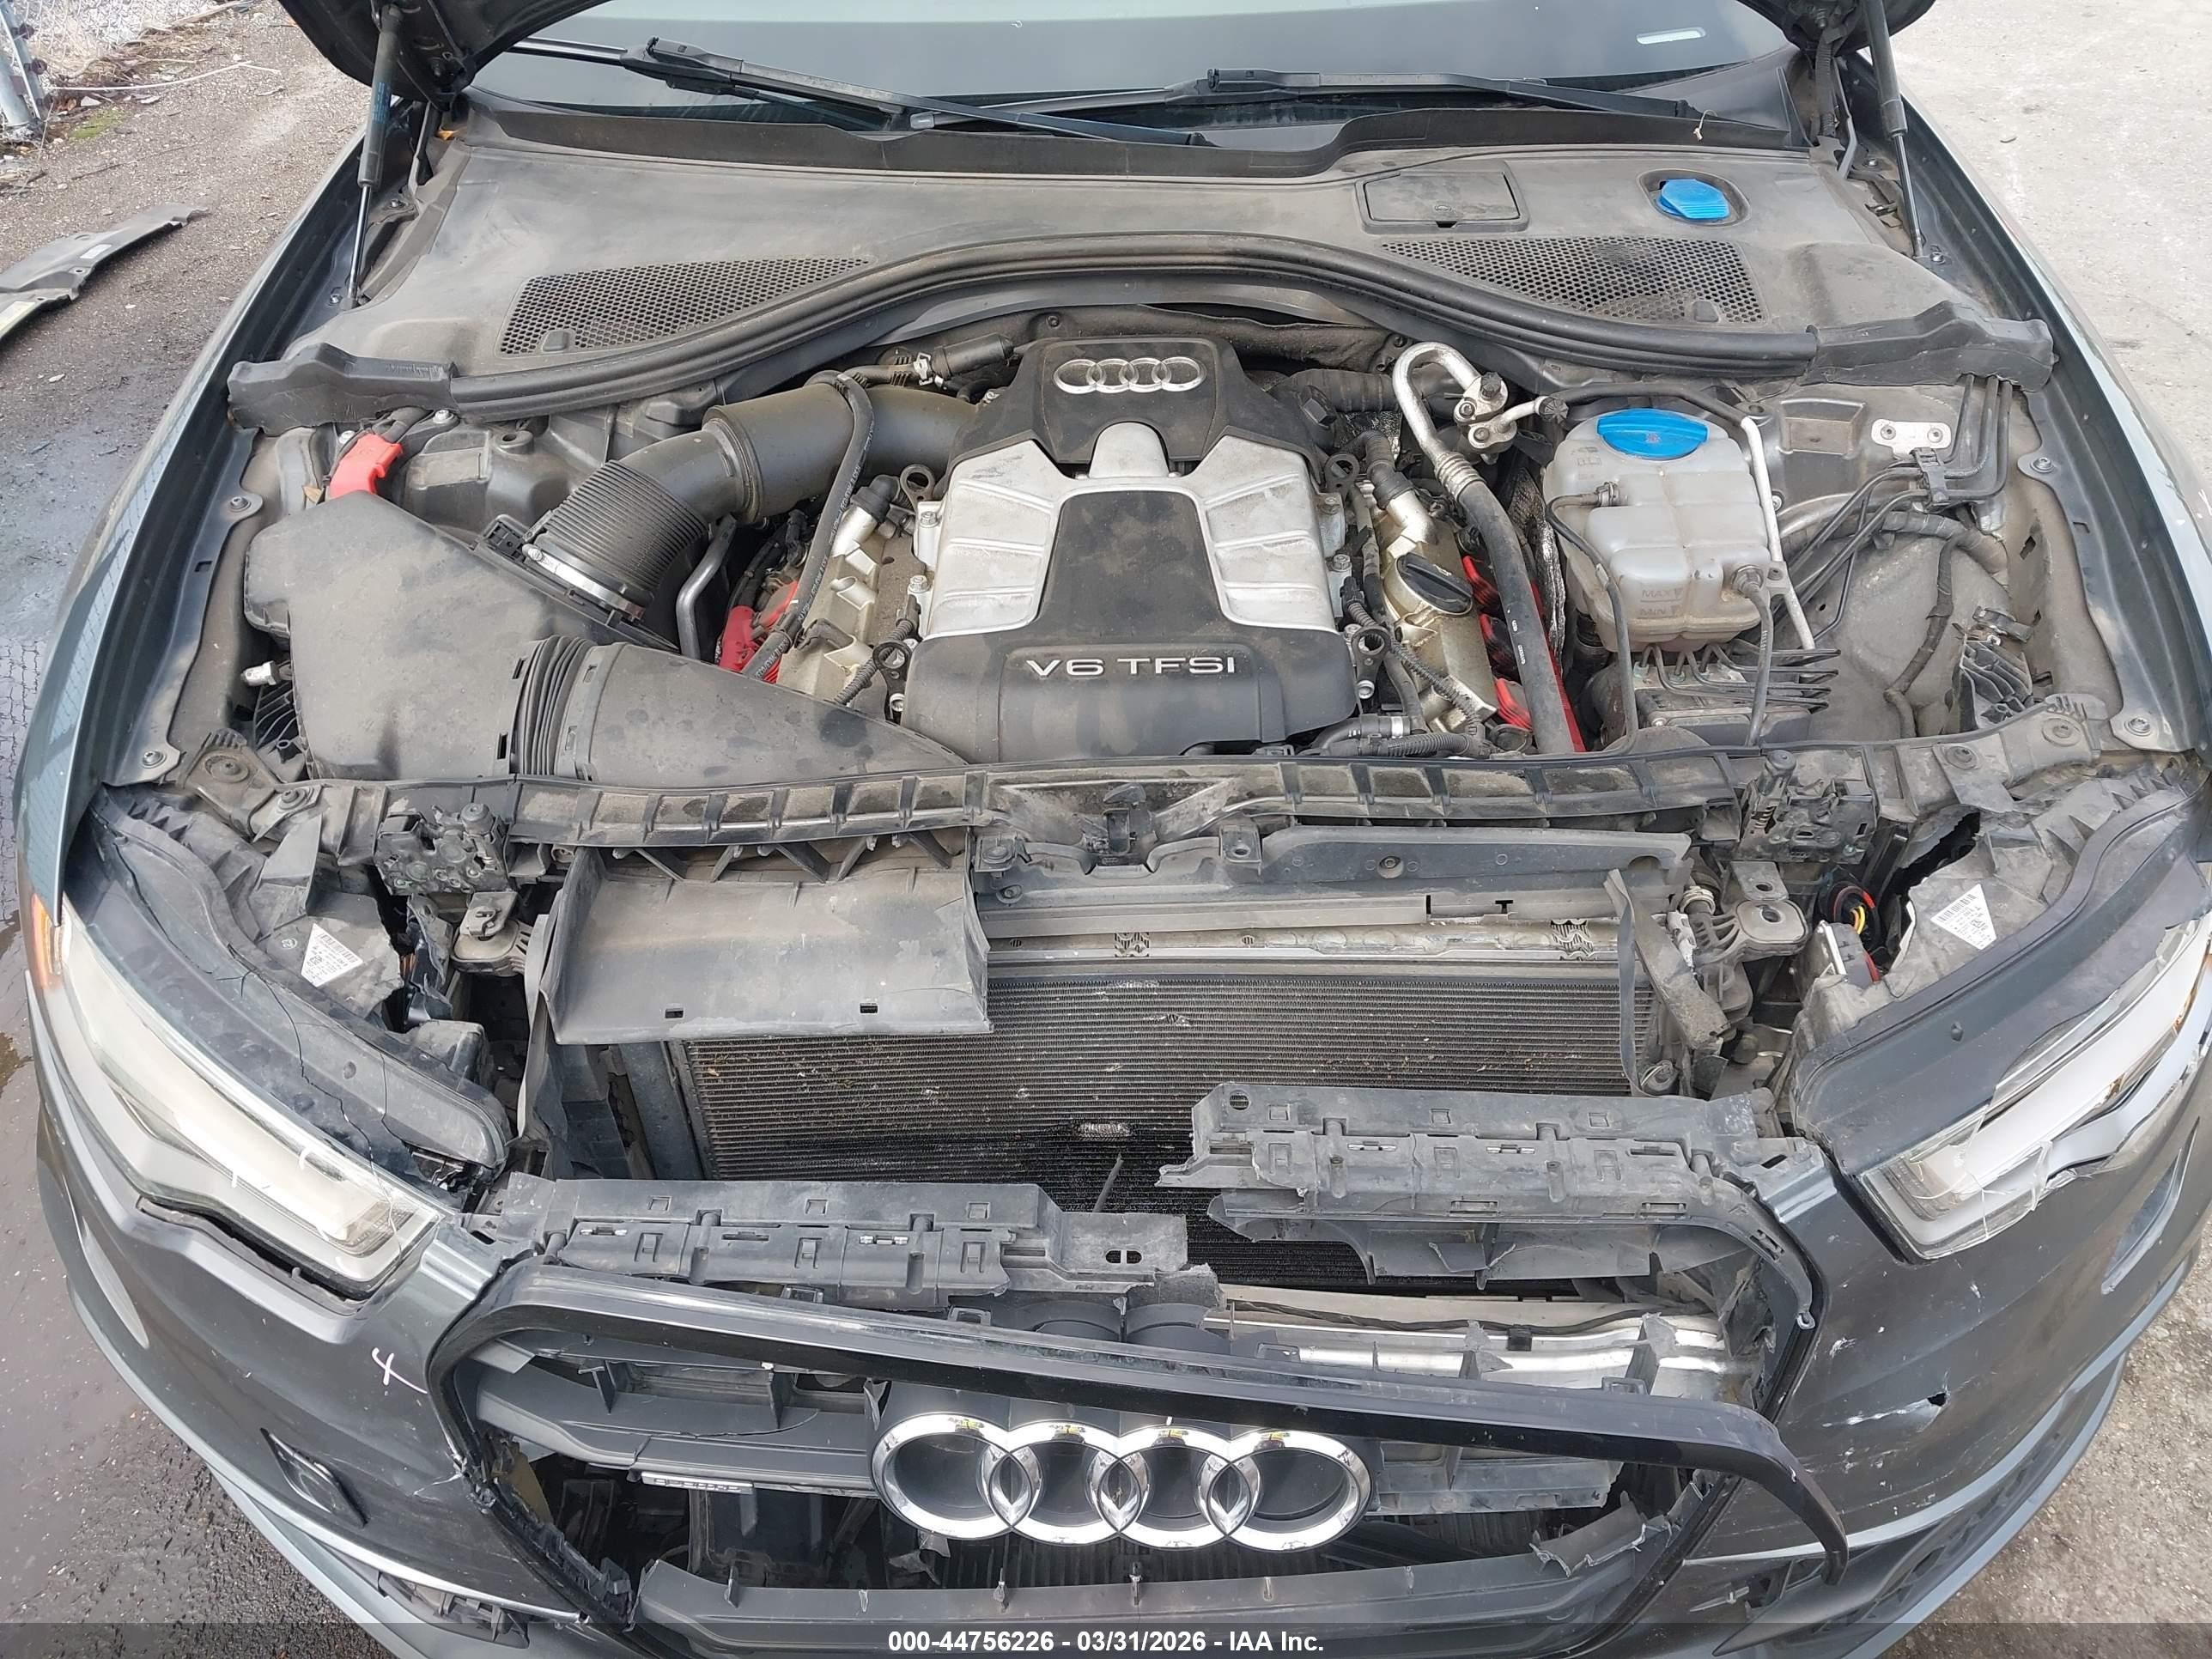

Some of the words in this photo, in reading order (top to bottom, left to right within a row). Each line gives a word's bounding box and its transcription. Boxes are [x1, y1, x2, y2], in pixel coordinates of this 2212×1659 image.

[1641, 588, 1671, 599] MAX
[1025, 659, 1105, 677] V6
[1116, 656, 1236, 675] TFSI
